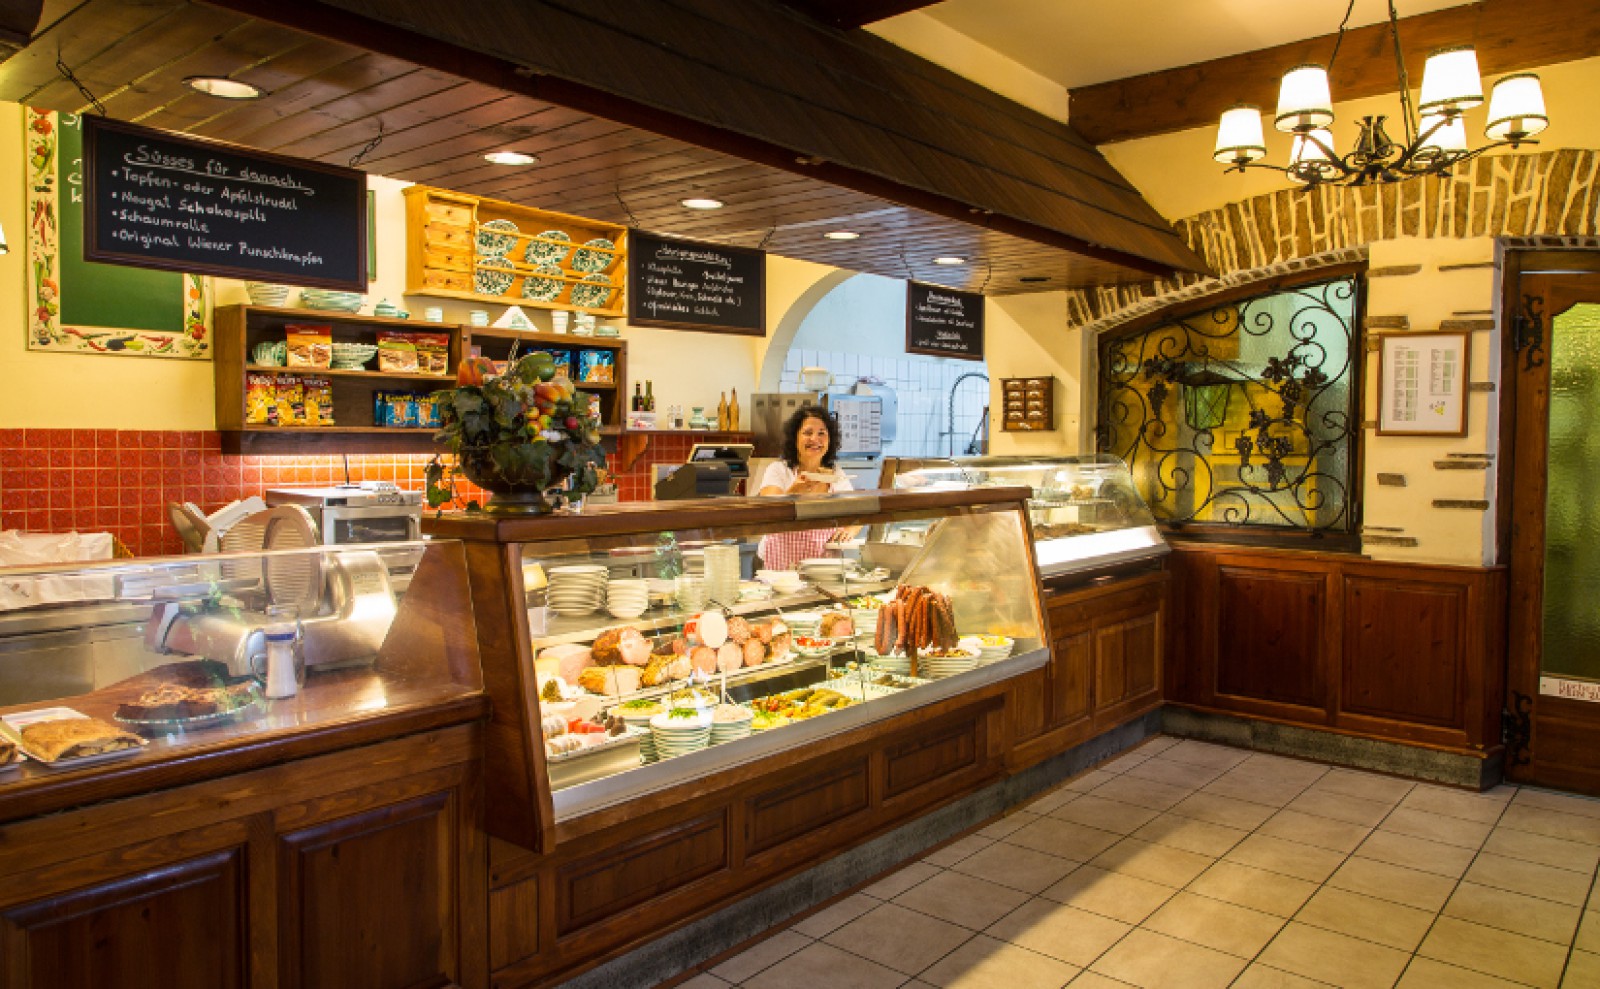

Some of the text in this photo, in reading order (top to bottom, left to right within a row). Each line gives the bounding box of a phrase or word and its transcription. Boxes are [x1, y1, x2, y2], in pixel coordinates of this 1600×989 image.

[136, 145, 195, 169] Süsses
[205, 158, 230, 176] für
[121, 191, 172, 212] Nougat
[183, 181, 215, 195] oder
[220, 185, 298, 210] Apfelstrudel
[119, 229, 323, 267] Original Wiener Punschkrapfen
